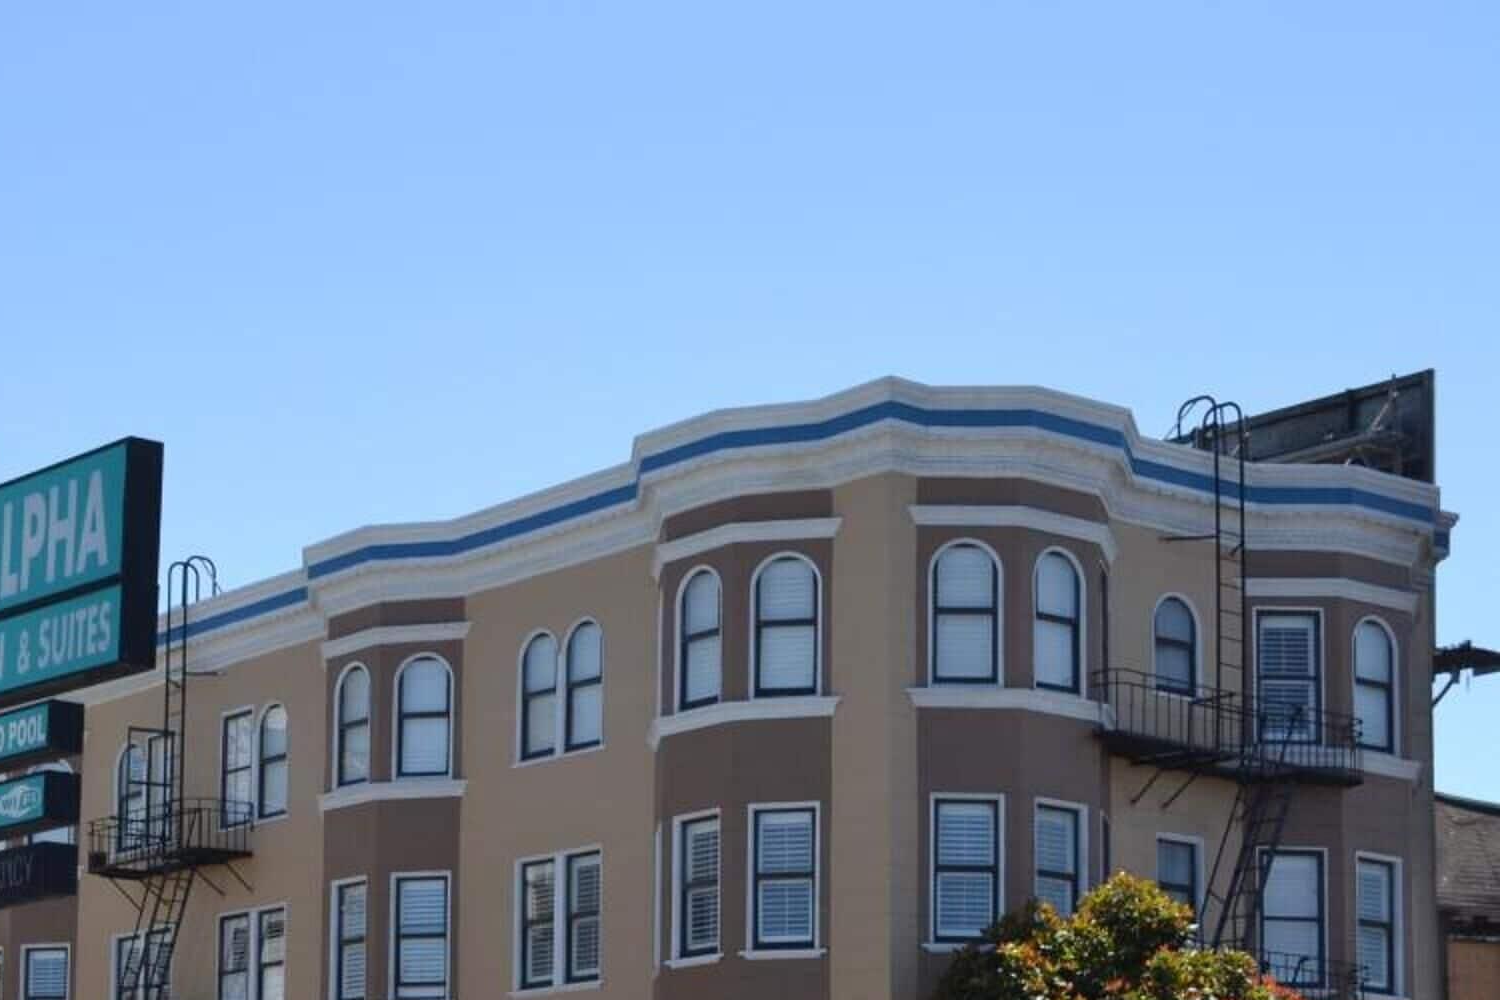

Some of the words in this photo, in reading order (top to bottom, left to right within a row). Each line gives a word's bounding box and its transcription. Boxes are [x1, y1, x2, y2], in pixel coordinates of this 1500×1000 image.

[16, 630, 31, 675] &
[37, 602, 112, 667] SUITES
[8, 714, 47, 750] POOL
